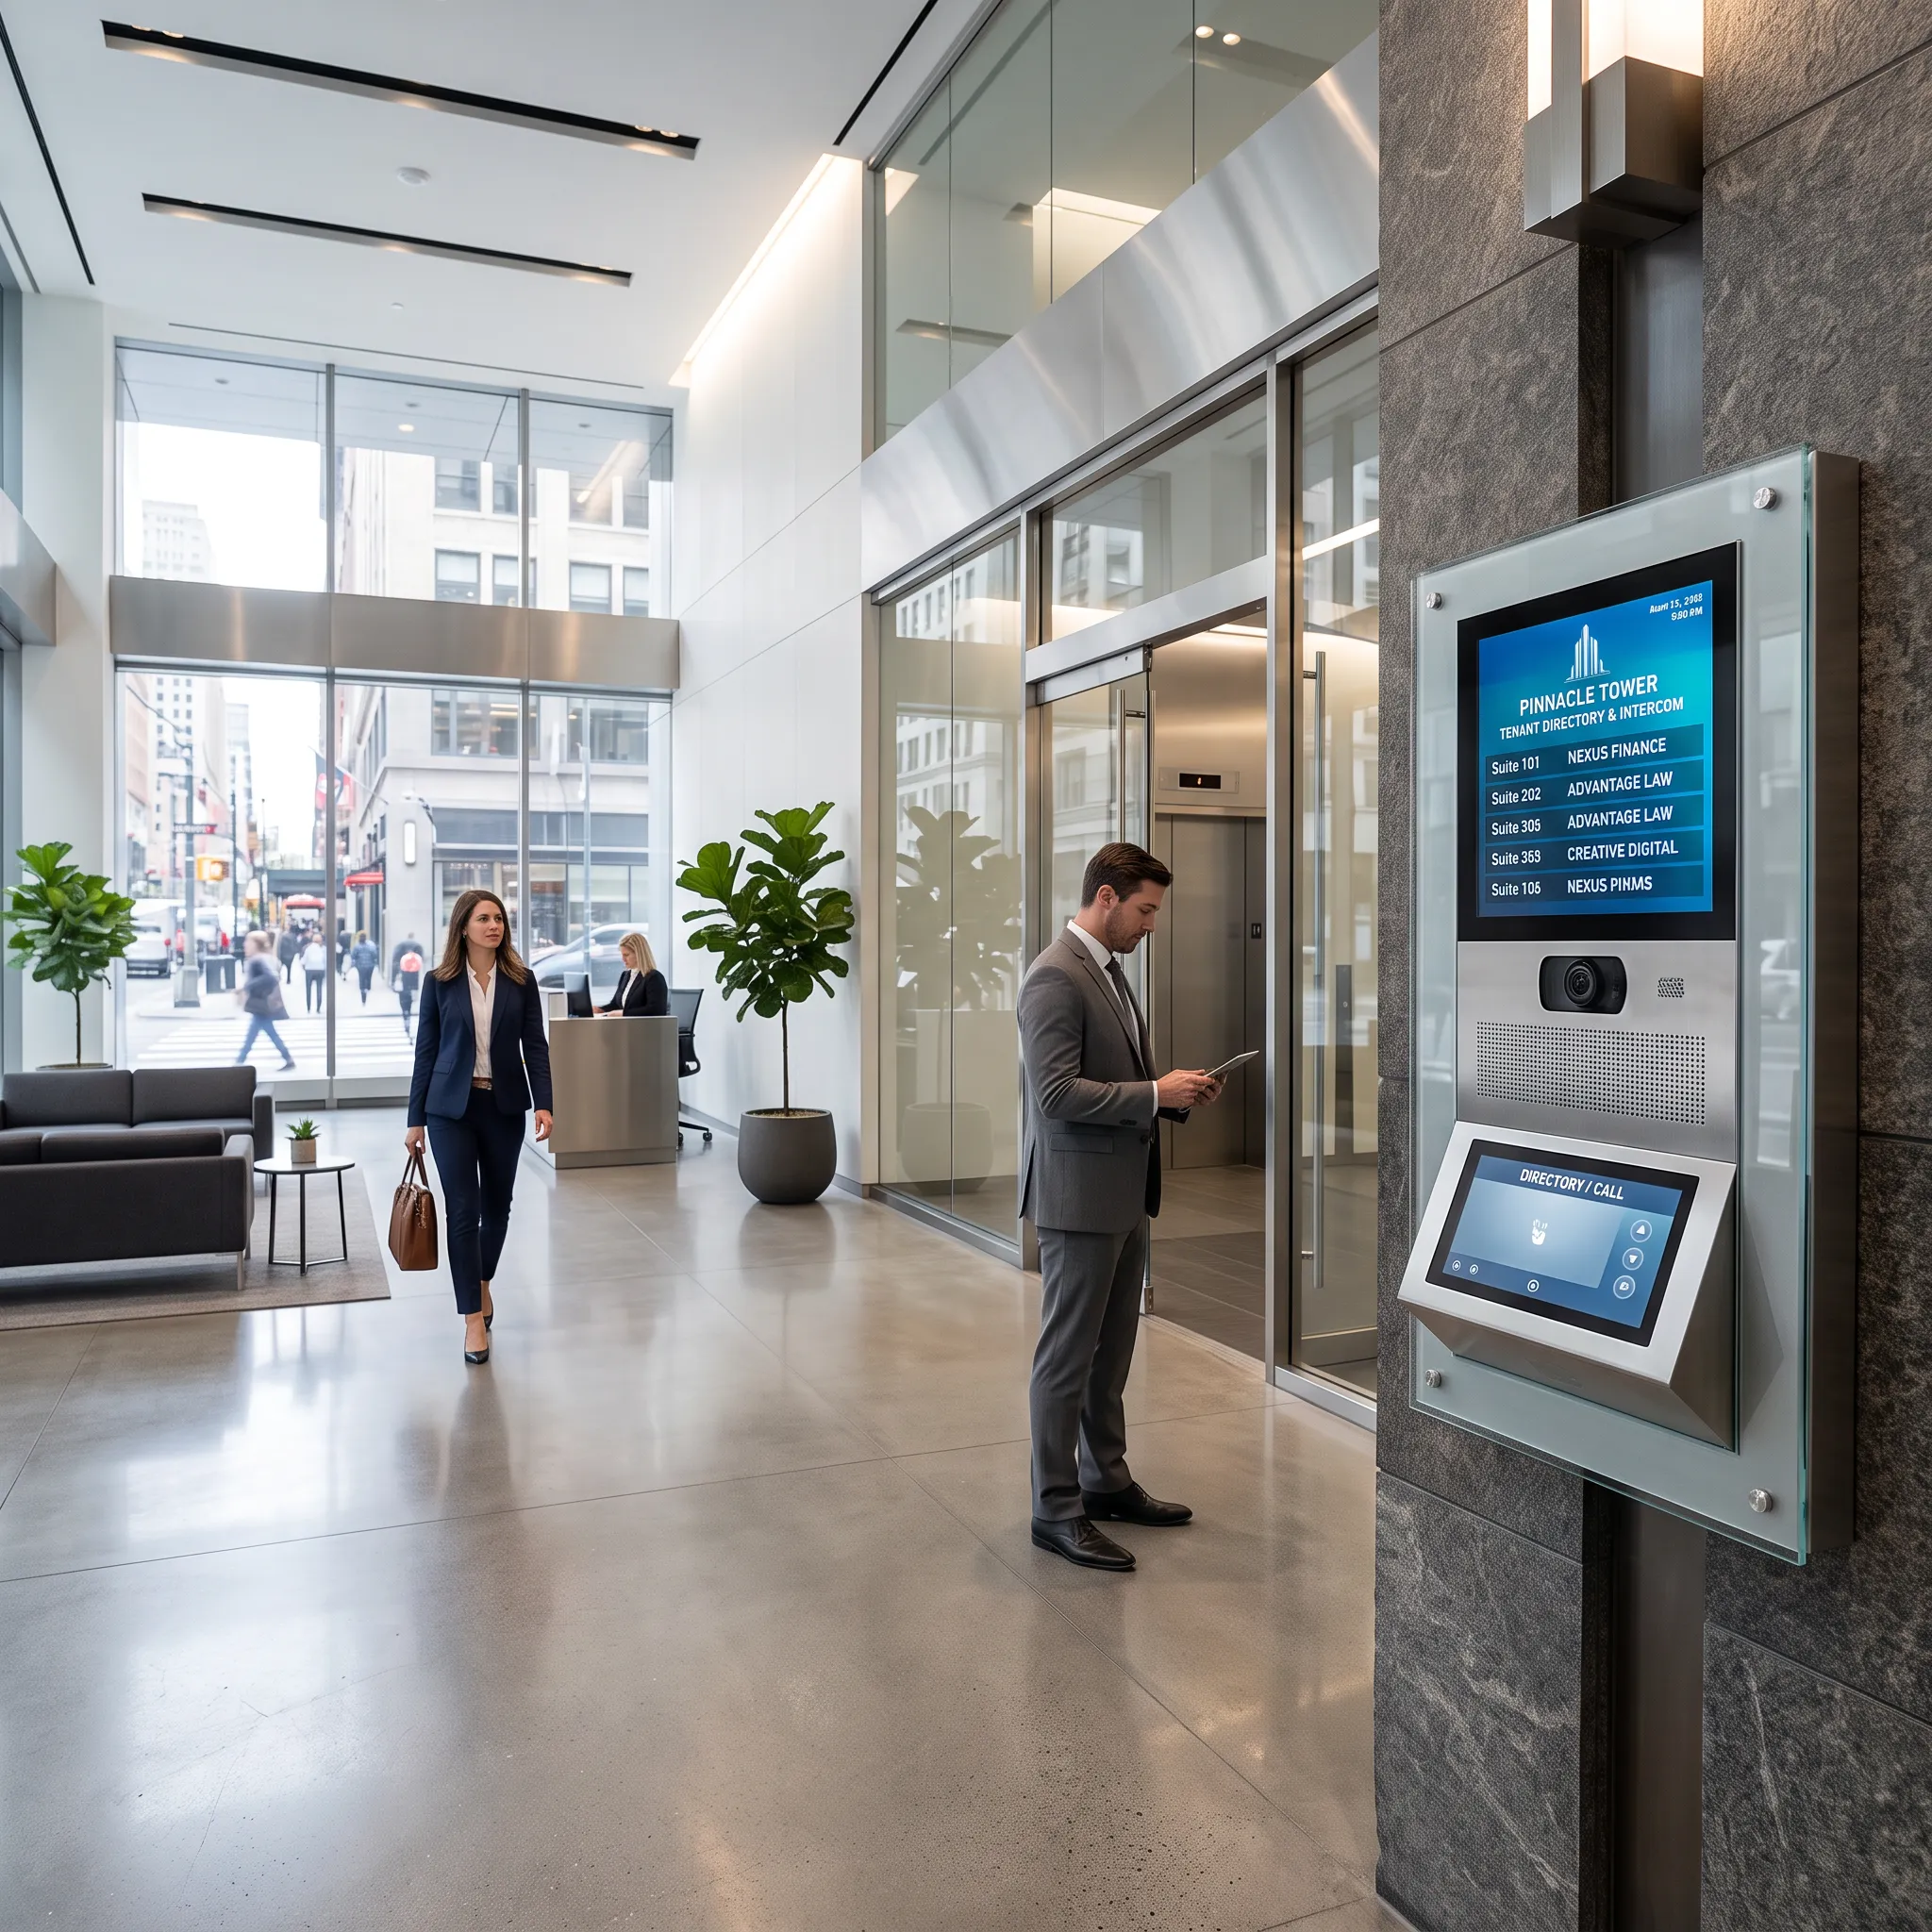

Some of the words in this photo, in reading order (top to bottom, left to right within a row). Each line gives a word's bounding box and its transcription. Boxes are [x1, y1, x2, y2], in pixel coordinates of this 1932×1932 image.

[1520, 685, 1595, 717] PINNACLE
[1598, 674, 1658, 702] TOWER
[1499, 721, 1541, 740] TENANT
[1542, 709, 1606, 733] DIRECTORY
[1607, 708, 1617, 722] &
[1620, 696, 1684, 720] INTERCOM
[1491, 759, 1520, 775] Suite
[1522, 756, 1540, 771] 101
[1568, 745, 1608, 765] NEXUS
[1611, 737, 1667, 759] FINANCE
[1491, 791, 1520, 806] Suite
[1521, 787, 1541, 802] 202
[1567, 774, 1641, 797] ADVANTAGE
[1644, 771, 1674, 789] LAW
[1491, 821, 1520, 836] Suite
[1567, 808, 1641, 830] ADVANTAGE
[1644, 805, 1674, 823] LAW
[1491, 852, 1519, 866] Suite
[1567, 842, 1625, 861] CREATIVE
[1628, 840, 1679, 858] DIGITAL
[1491, 882, 1519, 896] Suite
[1567, 877, 1607, 893] NEXUS
[1519, 1168, 1586, 1193] DIRECTORY
[1593, 1182, 1624, 1200] CALL
